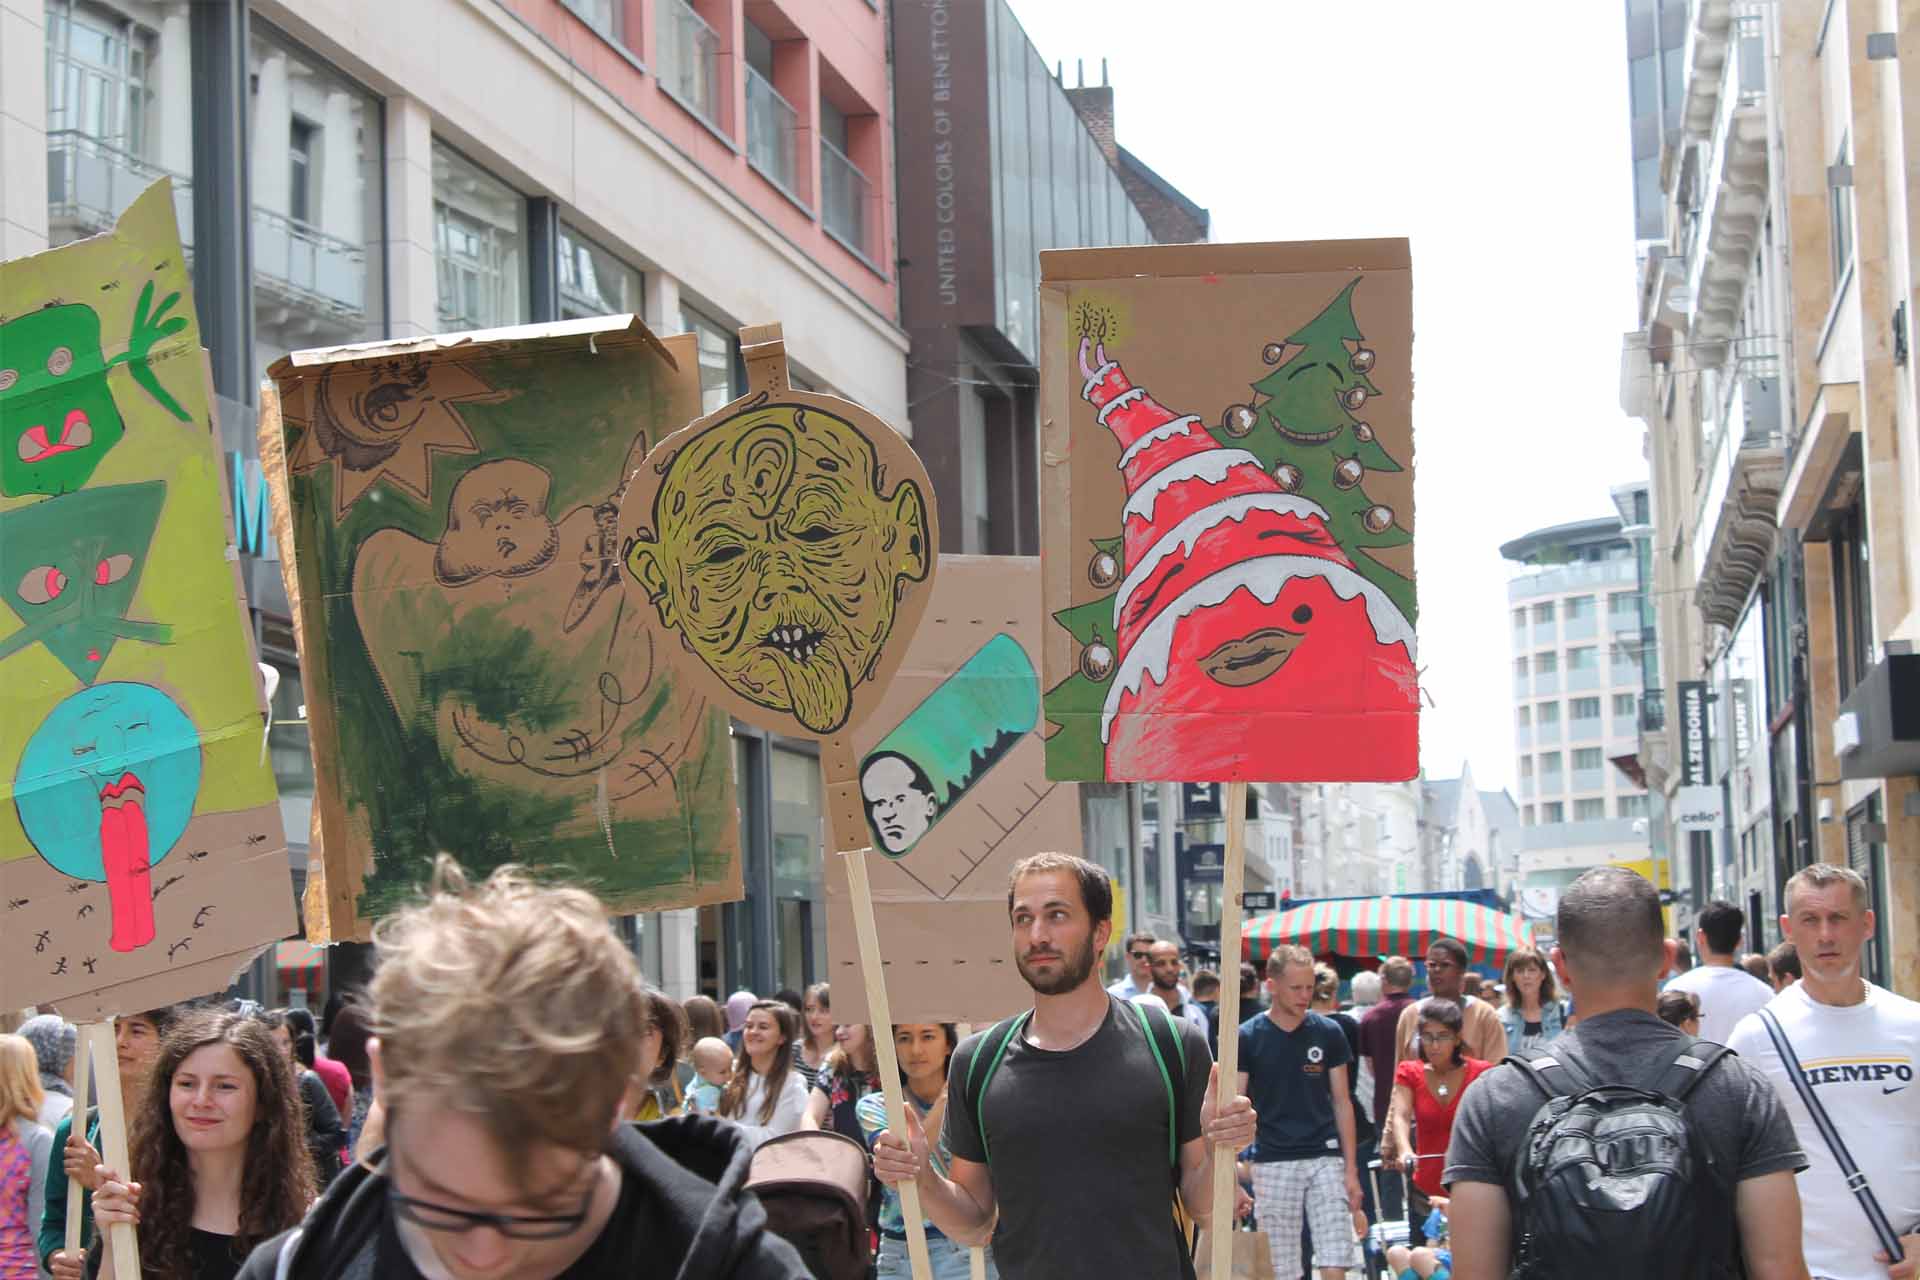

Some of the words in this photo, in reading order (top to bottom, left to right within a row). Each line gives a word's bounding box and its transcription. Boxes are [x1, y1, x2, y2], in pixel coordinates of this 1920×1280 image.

[933, 110, 952, 135] OF
[936, 142, 955, 223] COLORS
[938, 229, 956, 305] UNITED
[1686, 688, 1704, 787] ALZEDONIA
